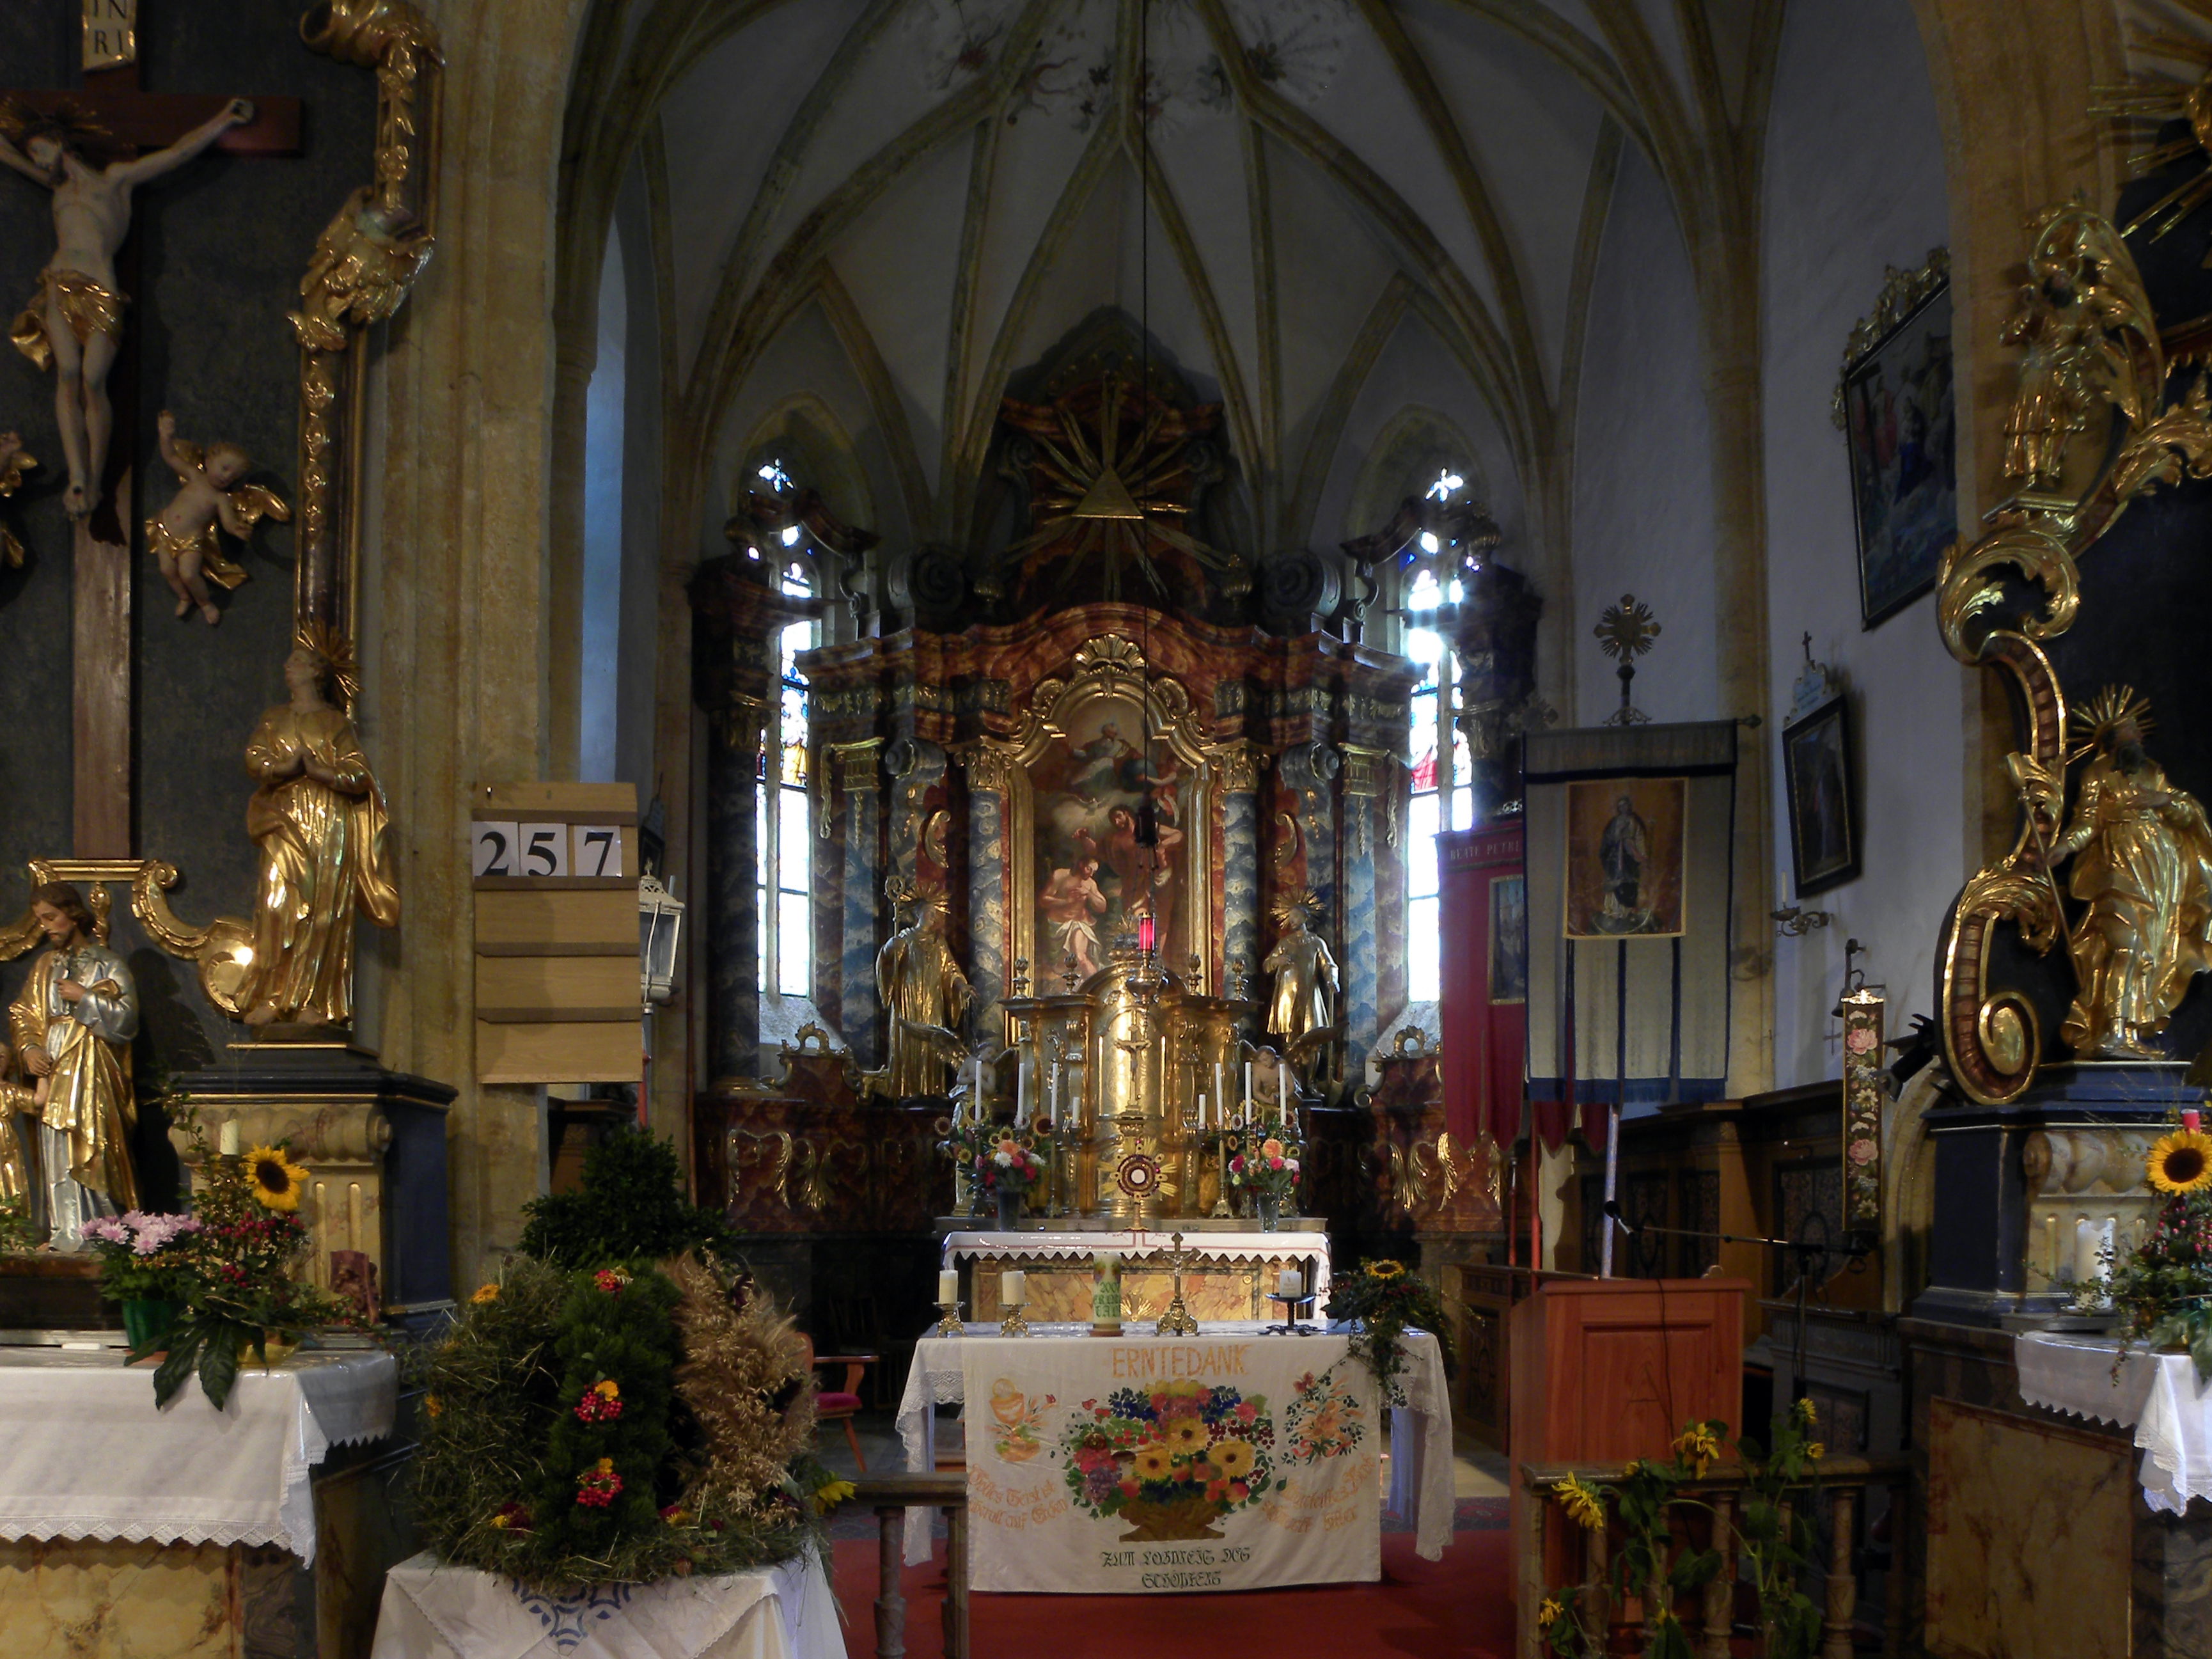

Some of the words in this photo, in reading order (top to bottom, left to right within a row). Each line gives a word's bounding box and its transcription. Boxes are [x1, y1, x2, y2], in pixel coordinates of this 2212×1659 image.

[94, 29, 123, 55] RI
[480, 831, 614, 876] 257
[1111, 1344, 1251, 1378] ERNTEDANK
